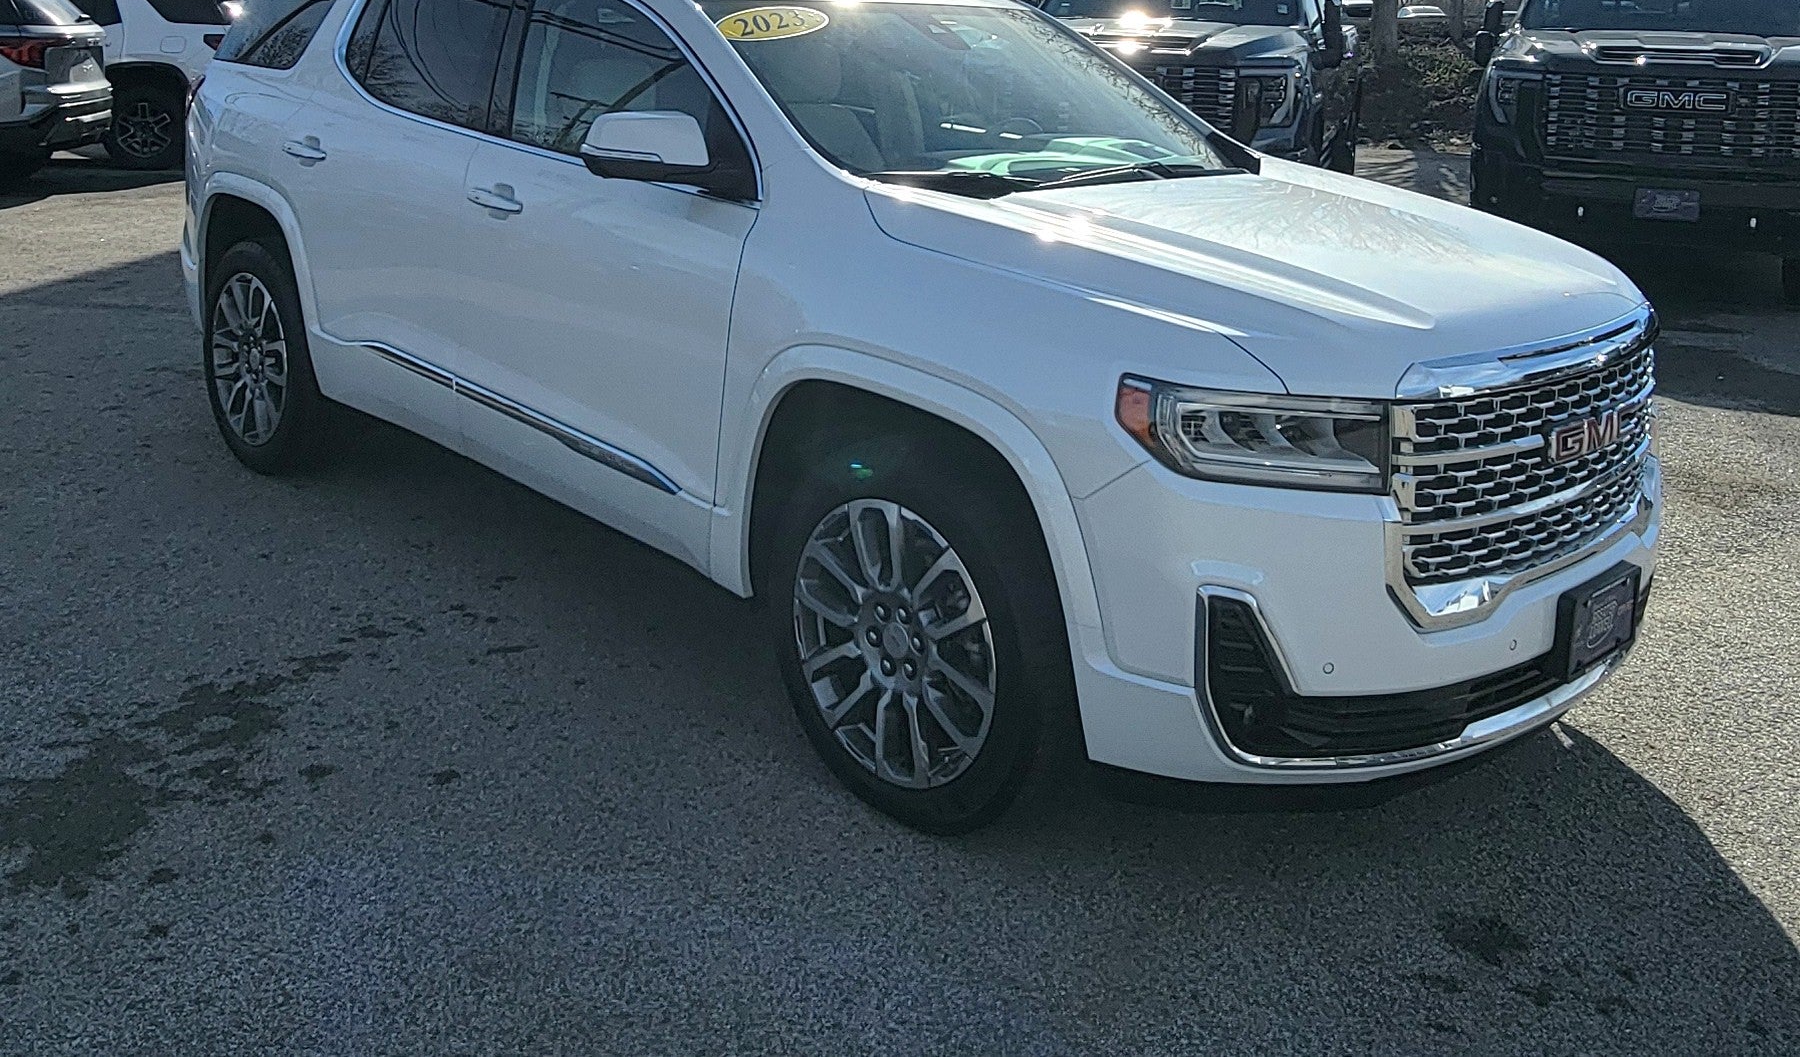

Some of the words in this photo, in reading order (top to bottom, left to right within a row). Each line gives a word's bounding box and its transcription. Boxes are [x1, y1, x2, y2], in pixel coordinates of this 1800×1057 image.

[733, 9, 806, 37] 2023
[1627, 90, 1727, 111] GMC
[1550, 403, 1642, 463] GMC
